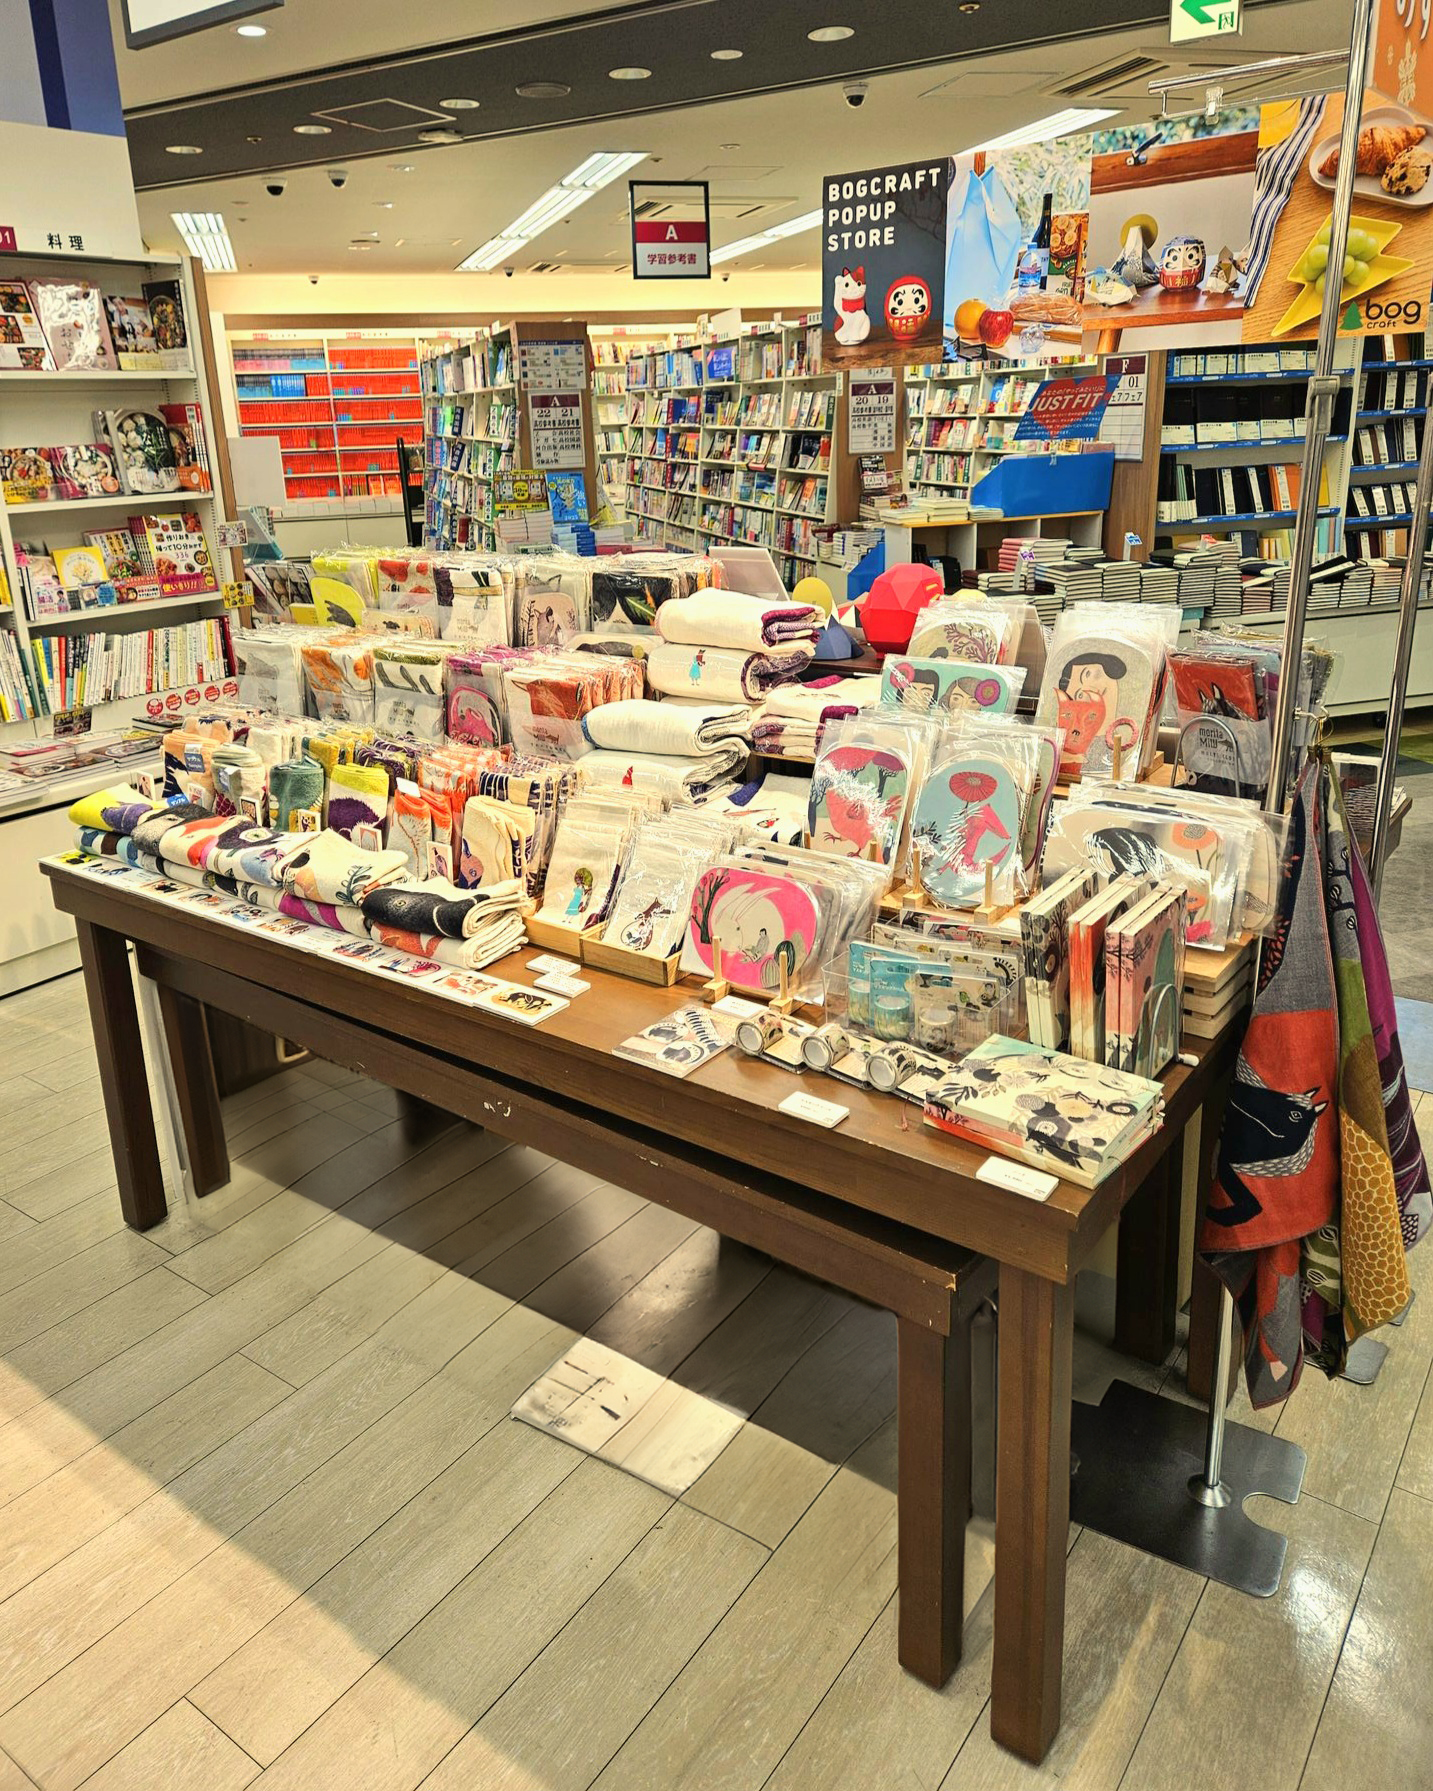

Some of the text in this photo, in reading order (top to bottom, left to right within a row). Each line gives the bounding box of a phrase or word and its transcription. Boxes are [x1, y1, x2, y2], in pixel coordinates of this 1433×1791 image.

[828, 167, 941, 202] BOGCRAFT
[828, 201, 896, 227] POPUP
[665, 224, 678, 241] A
[827, 226, 896, 252] STORE
[47, 232, 84, 251] 料理
[647, 253, 697, 265] 学習参考書
[1366, 298, 1421, 325] bog
[1366, 320, 1397, 330] craft
[1121, 359, 1129, 374] F
[868, 384, 877, 394] A
[1128, 376, 1139, 388] 01
[550, 395, 560, 407] A
[856, 395, 888, 405] 20 19
[1028, 393, 1103, 413] JUST FIT
[537, 407, 573, 418] 22 21
